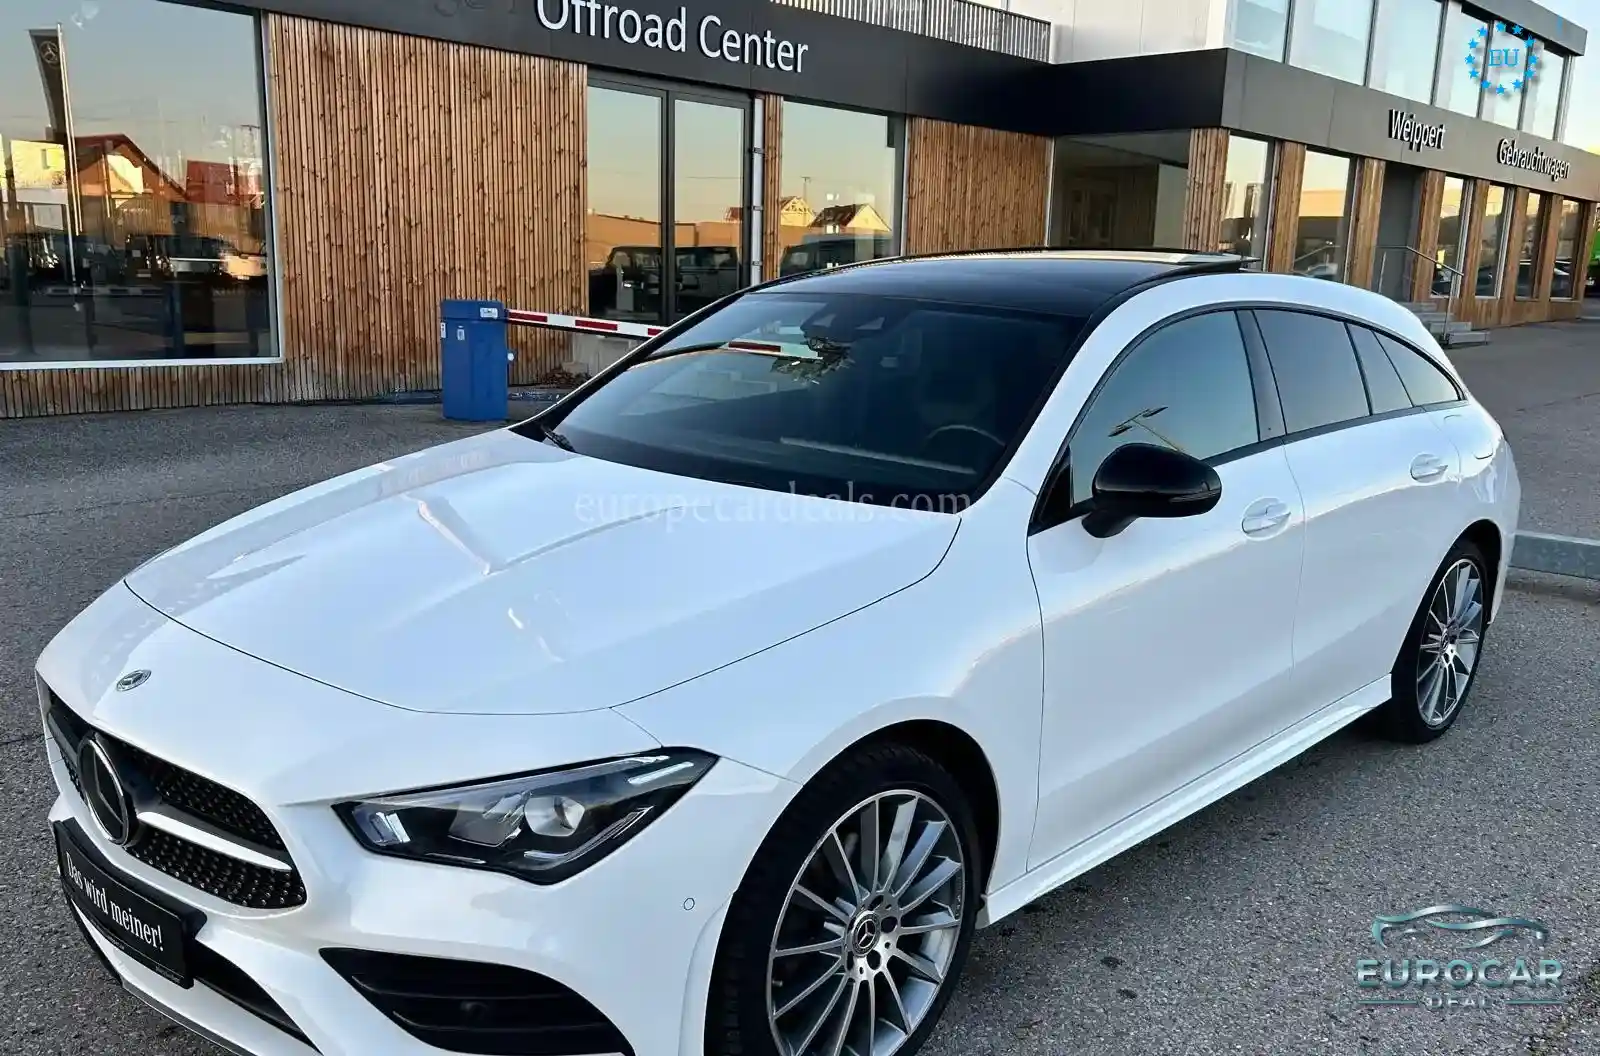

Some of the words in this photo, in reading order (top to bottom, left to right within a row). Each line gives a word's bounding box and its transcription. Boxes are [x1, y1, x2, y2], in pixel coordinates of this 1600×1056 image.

[537, 0, 687, 52] Offroad
[699, 15, 809, 73] Center
[1391, 109, 1446, 152] Weippert
[1498, 139, 1571, 181] Gebrauchtwagen
[66, 852, 84, 889] Das
[84, 877, 109, 915] wird
[110, 900, 165, 952] meiner!
